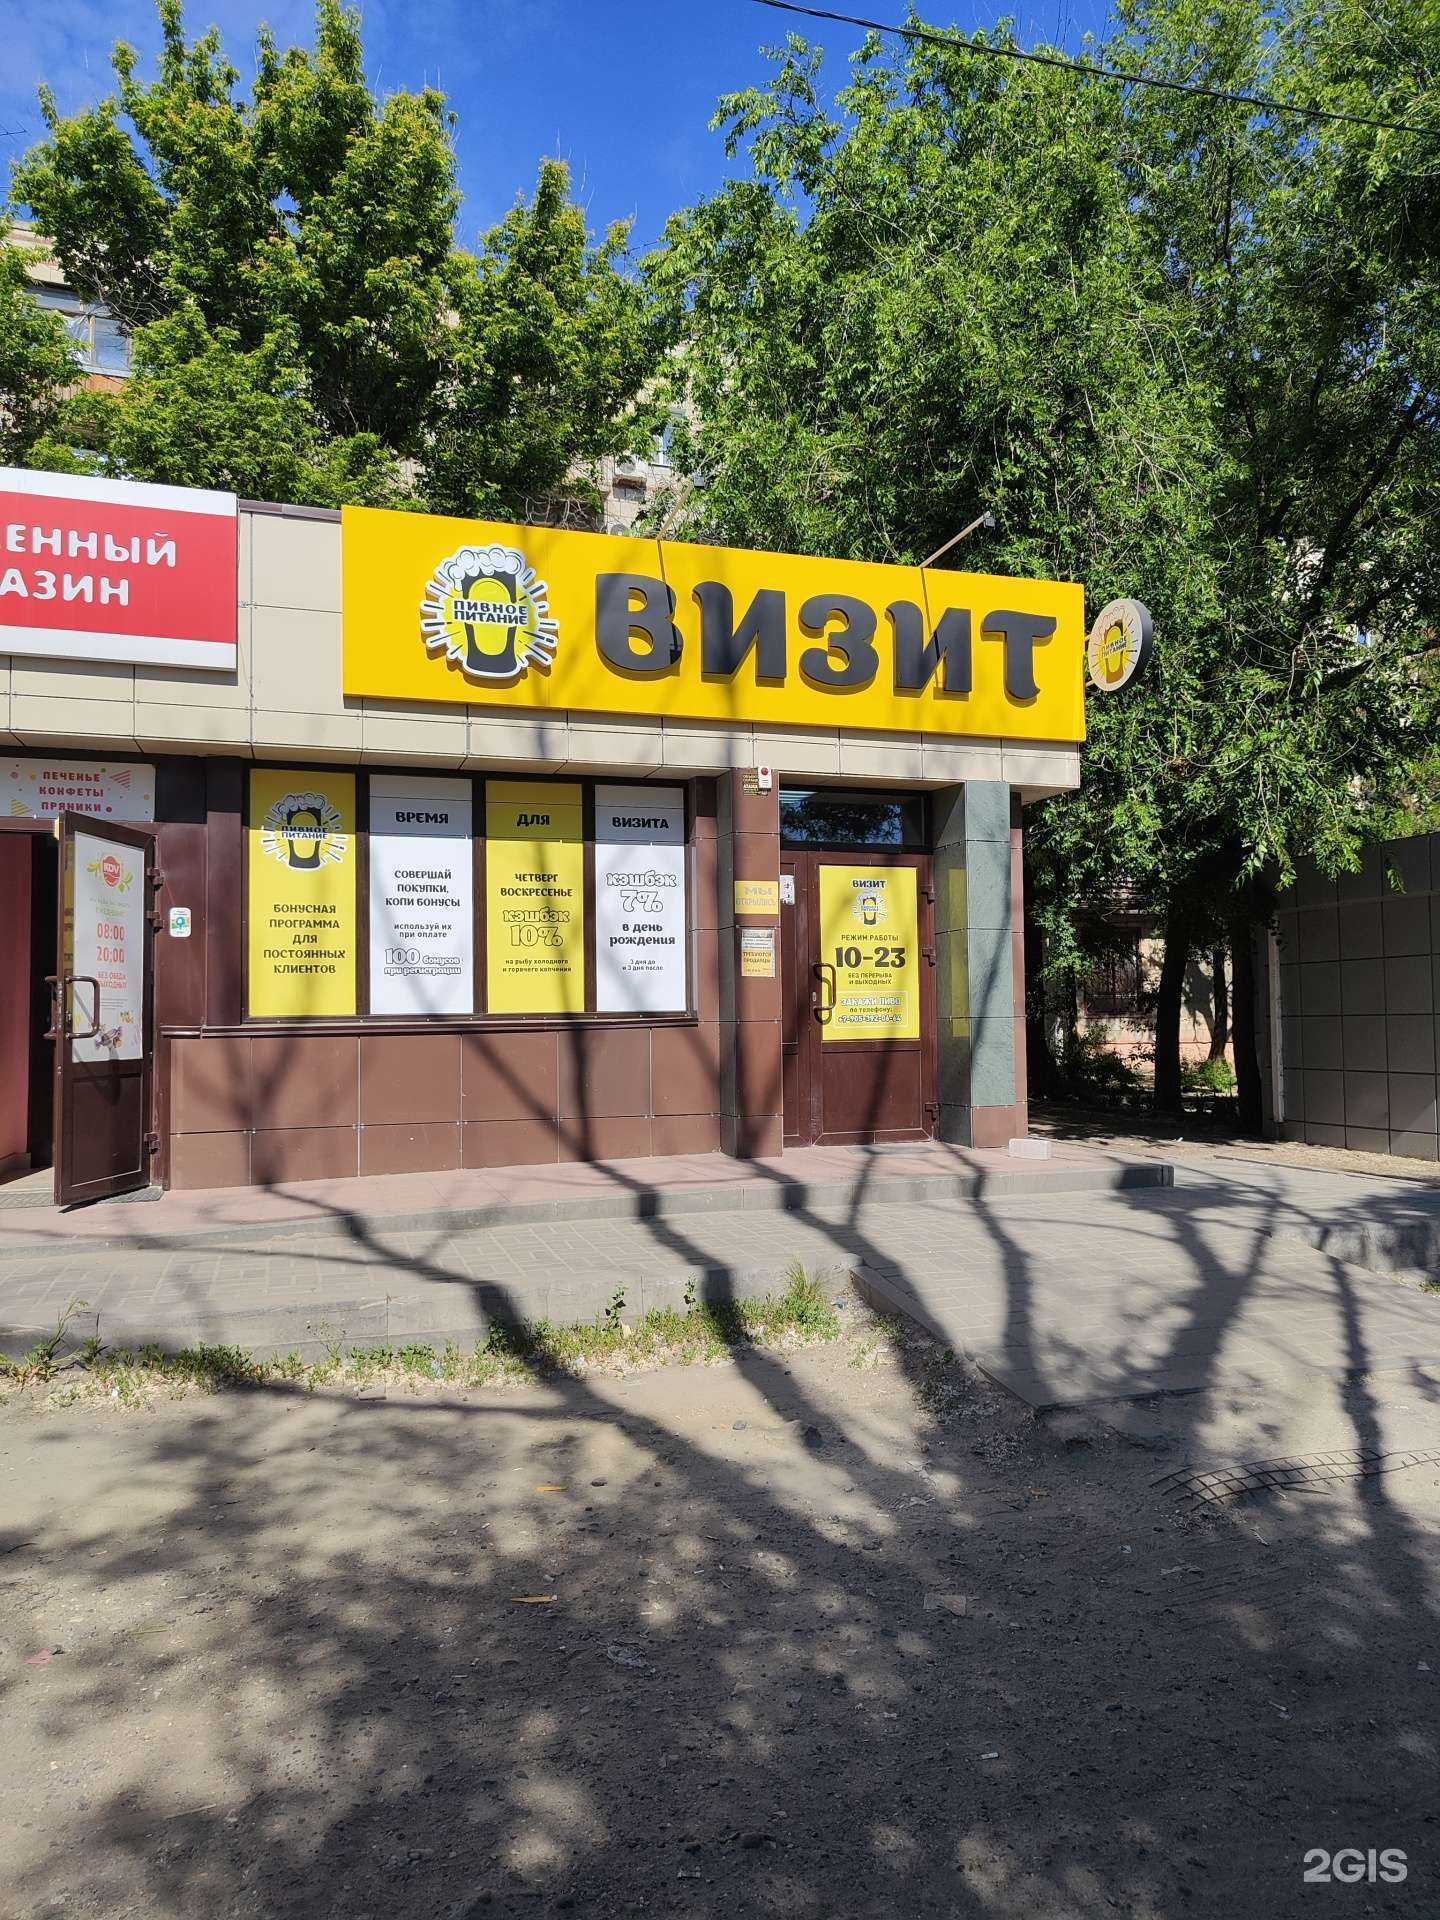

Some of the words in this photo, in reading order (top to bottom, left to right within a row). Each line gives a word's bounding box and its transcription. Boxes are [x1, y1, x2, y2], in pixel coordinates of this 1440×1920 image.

[6, 523, 176, 568] ЕННЫЙ
[0, 567, 129, 607] АЗИН
[454, 600, 528, 616] ПИВНОЕ
[454, 610, 528, 625] ПИТАНИЕ
[594, 572, 1058, 701] ВИЗИТ
[43, 771, 101, 782] ПЕЧЕНЬЕ
[39, 786, 104, 798] КОНФЕТЫ
[41, 801, 102, 813] ПРЯНИКИ
[395, 811, 449, 825] ВРЕМЯ
[516, 813, 550, 827] ДЛЯ
[612, 816, 670, 829] ВИЗИТА
[281, 825, 328, 834] ПИВНОЕ
[281, 831, 328, 840] ПИТАНИЕ
[103, 862, 120, 874] KDV
[394, 869, 452, 879] СОВЕРШАЙ
[515, 873, 559, 882] ЧЕТВЕРГ
[606, 870, 677, 887] кэшбэк
[397, 884, 449, 893] ПОКУПКИ,
[852, 880, 887, 889] ВИЗИТ
[500, 887, 573, 897] ВОСКРЕСЕНЬЕ
[385, 897, 414, 906] КОПИ
[416, 898, 460, 907] БОНУСЫ
[620, 889, 664, 913] 7%
[273, 903, 336, 914] БОНУСНАЯ
[503, 906, 570, 923] кэшбэк
[269, 918, 340, 929] ПРОГРАММА
[394, 923, 440, 931] используй
[622, 923, 629, 932] в
[632, 923, 663, 933] день
[97, 922, 125, 941] 08:00
[510, 924, 564, 947] 10%
[292, 934, 318, 945] ДЛЯ
[609, 936, 676, 947] рождения
[869, 934, 899, 942] РАБОТЫ
[97, 946, 125, 964] 20:00
[263, 949, 346, 959] ПОСТОЯННЫХ
[385, 948, 421, 965] 100
[422, 955, 461, 966] бонусов
[835, 946, 906, 968] 10-23
[273, 964, 336, 974] КЛИЕНТОВ
[384, 967, 402, 976] при
[402, 967, 462, 976] регистрации
